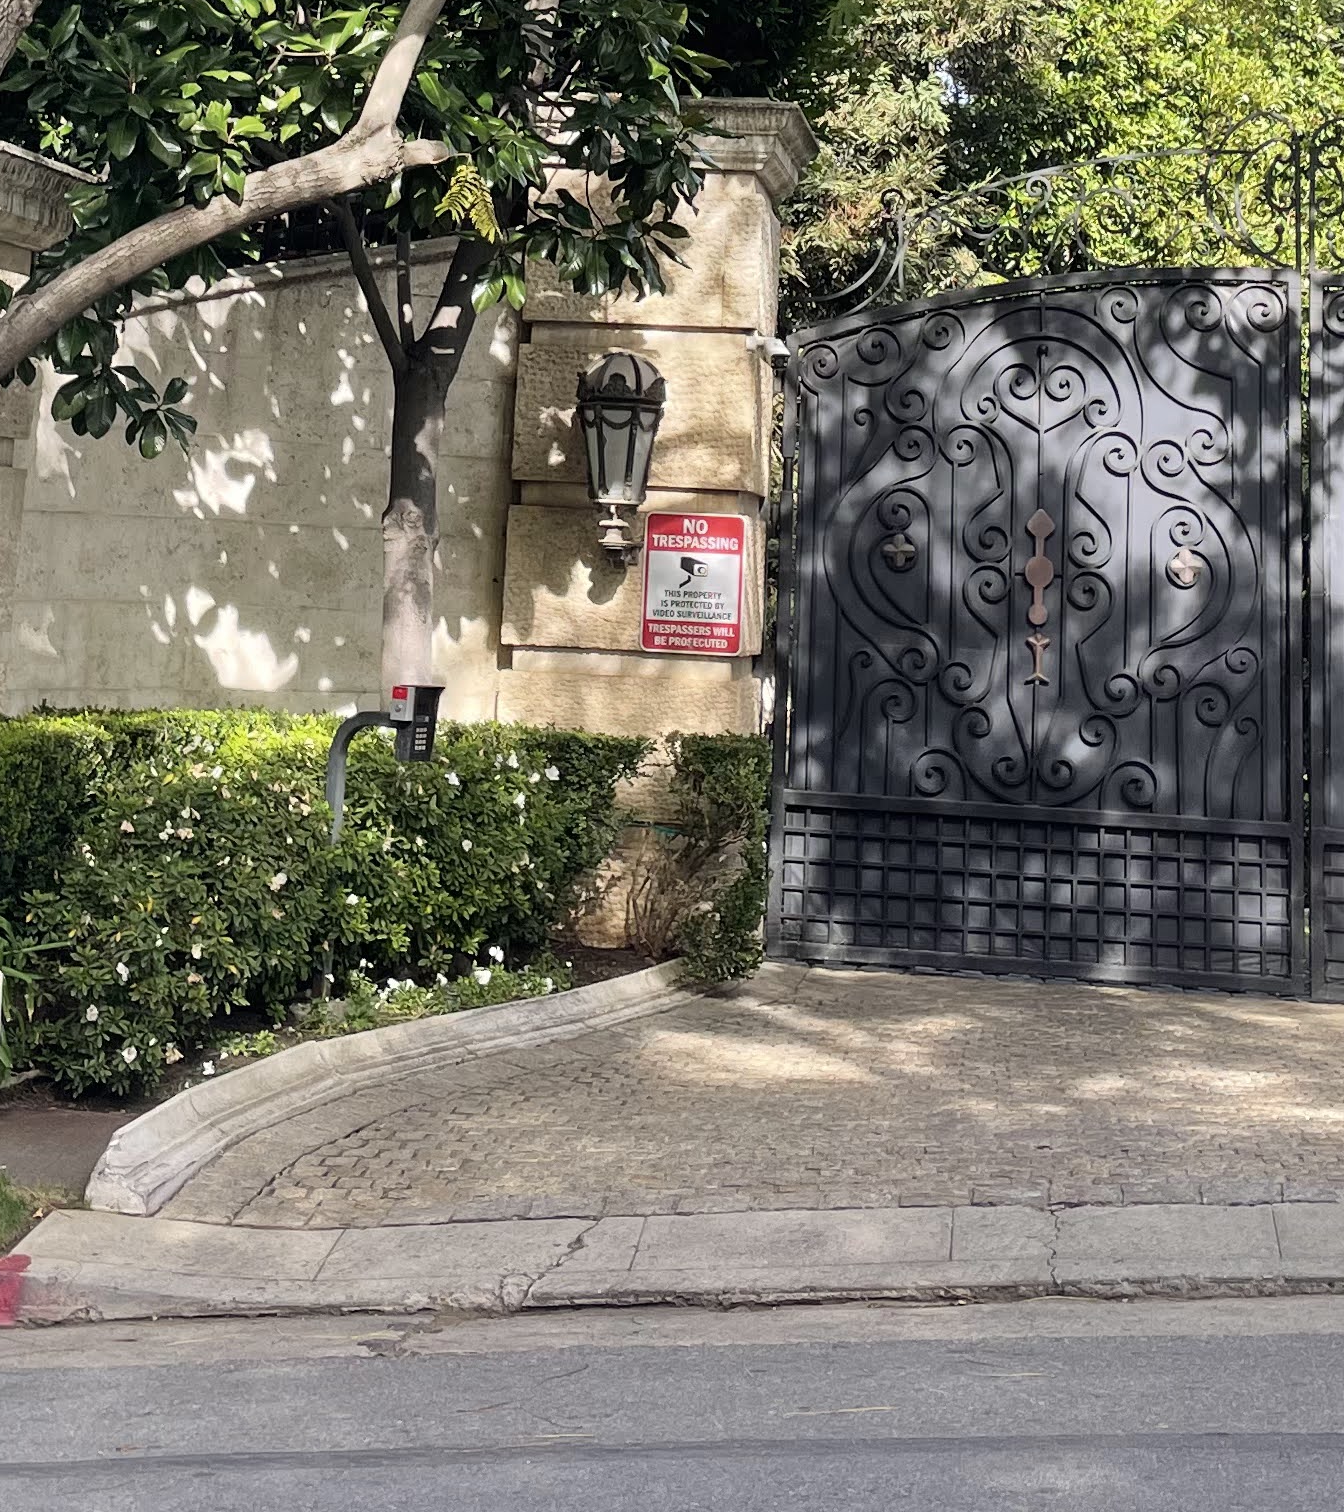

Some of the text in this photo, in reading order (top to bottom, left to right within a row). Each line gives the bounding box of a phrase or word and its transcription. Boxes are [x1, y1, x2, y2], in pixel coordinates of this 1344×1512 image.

[683, 519, 709, 534] NO
[652, 534, 739, 551] TRESPASSING
[664, 589, 722, 600] THIS PROPERTY
[660, 600, 725, 610] IS PROTECTED BY
[652, 609, 732, 621] VIDEO SURVEILLANCE
[648, 623, 735, 638] TRESPASSERS WILL
[654, 636, 728, 649] BE PROSECUTED
